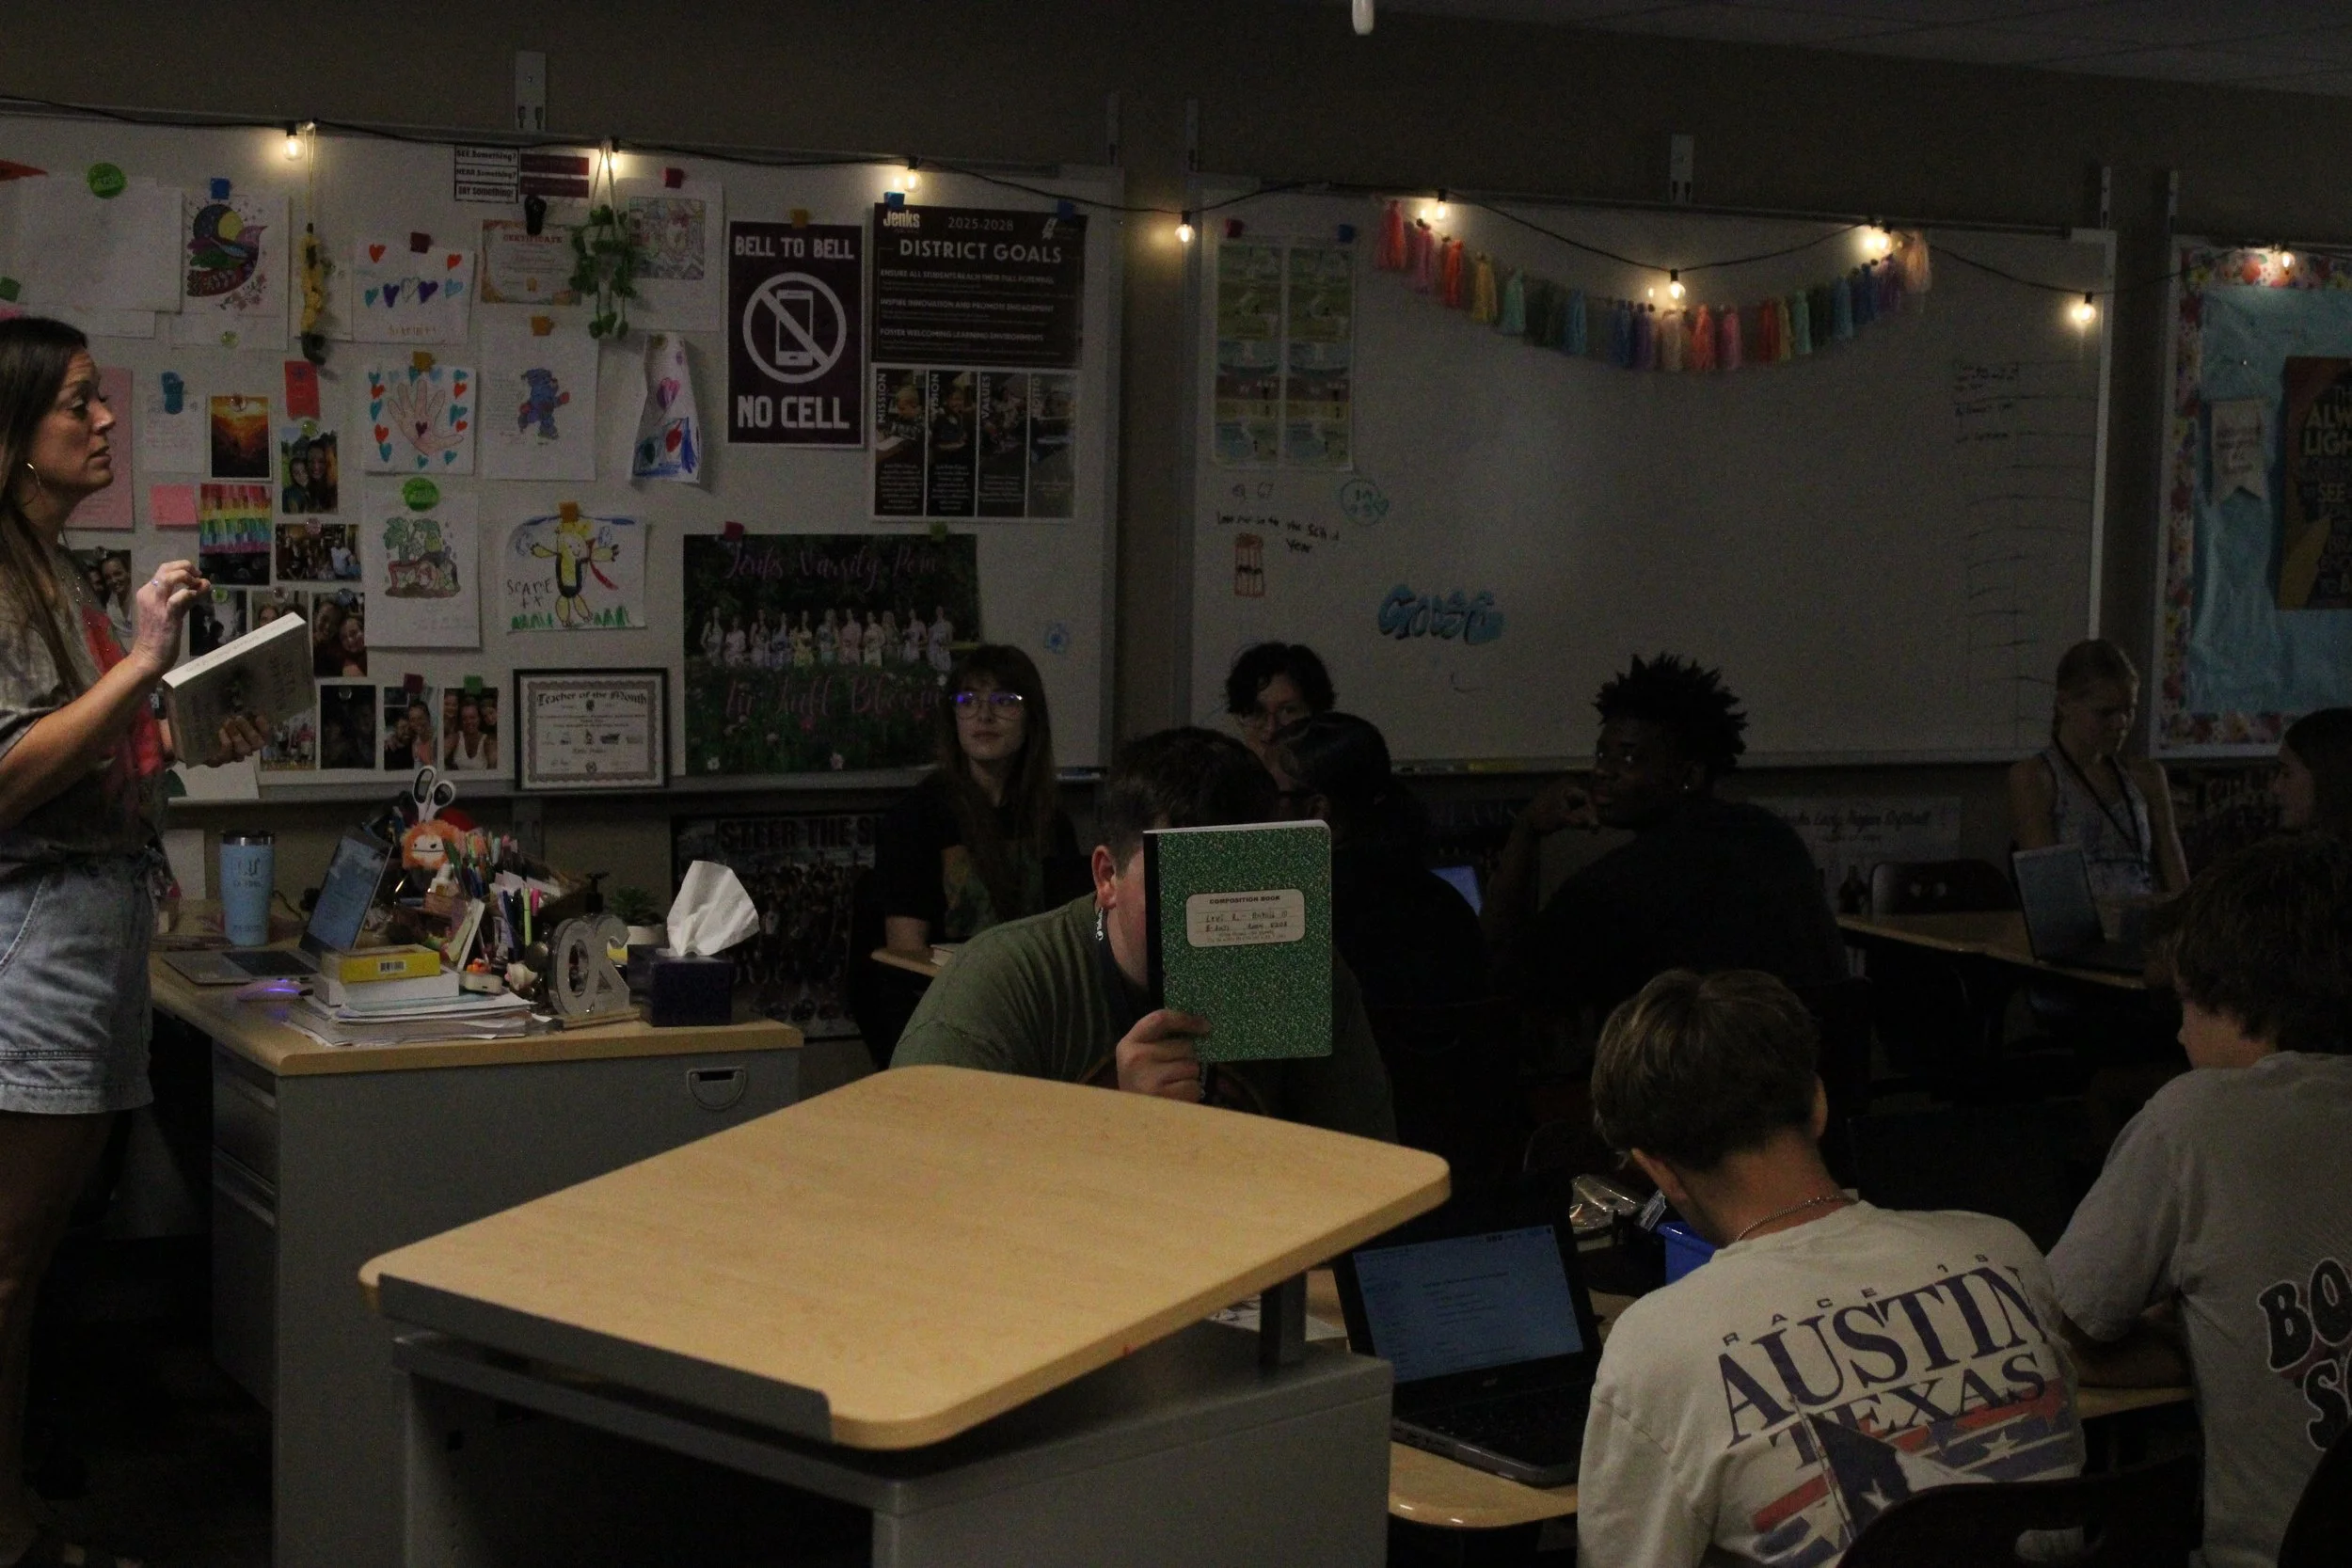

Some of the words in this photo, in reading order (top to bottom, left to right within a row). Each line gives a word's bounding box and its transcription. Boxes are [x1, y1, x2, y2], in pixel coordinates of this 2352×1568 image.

[472, 151, 516, 162] Something?
[477, 170, 516, 180] Something?
[883, 210, 921, 229] Jenks
[503, 234, 563, 244] CERTIFICATE
[735, 235, 775, 259] BELL
[780, 237, 805, 259] TO
[813, 238, 855, 261] BELL
[899, 239, 988, 260] DISTRICT
[993, 244, 1062, 264] GOALS
[876, 373, 887, 423] MISSION
[980, 376, 991, 420] VALUES
[737, 396, 773, 429] NO
[781, 396, 850, 430] CELL
[723, 543, 784, 580] Jenks
[800, 545, 882, 593] Varsity
[537, 691, 577, 706] Teacher
[580, 690, 591, 700] of
[612, 690, 647, 705] Month
[804, 817, 851, 847] THE
[1209, 896, 1259, 905] COMPOSITION
[1261, 895, 1280, 903] BOOK
[1718, 1266, 2047, 1449] AUSTIN
[1768, 1351, 2047, 1470] TEXAS
